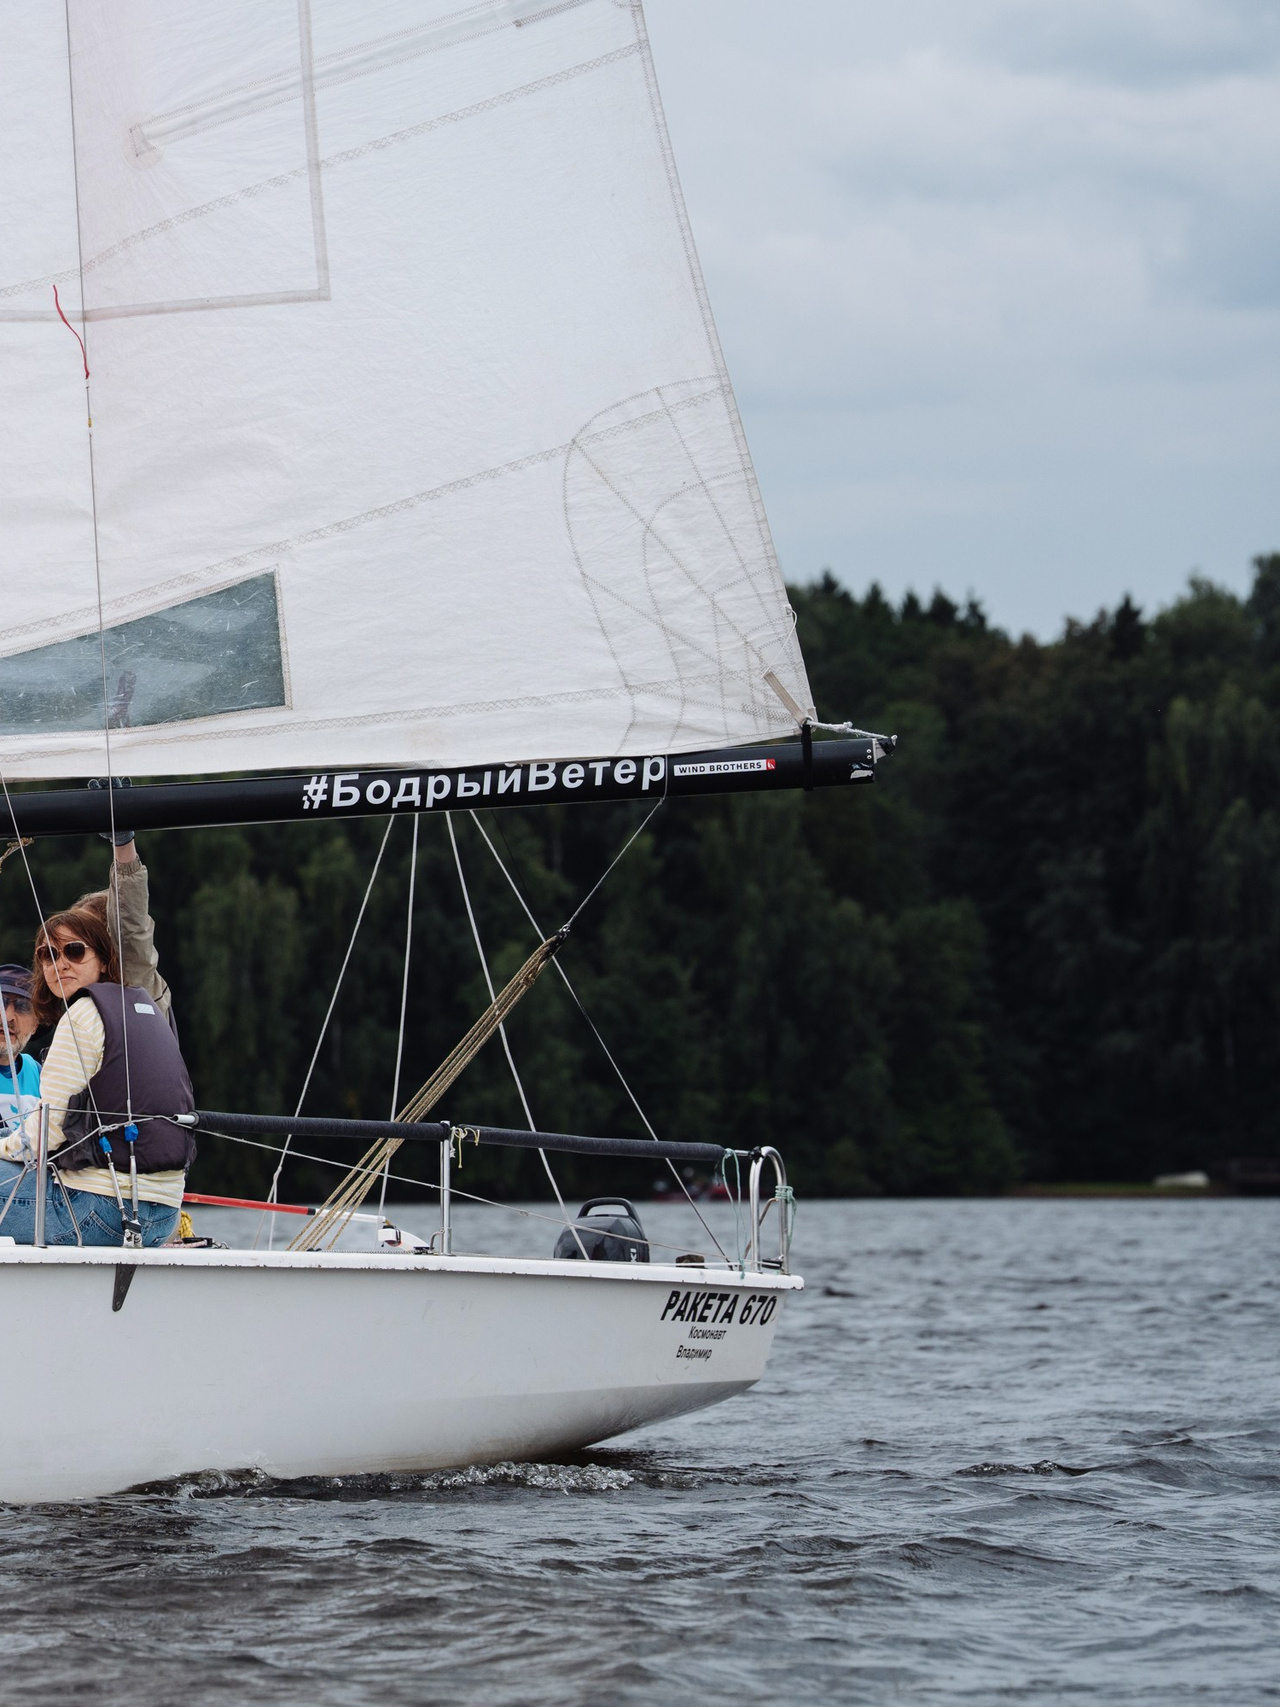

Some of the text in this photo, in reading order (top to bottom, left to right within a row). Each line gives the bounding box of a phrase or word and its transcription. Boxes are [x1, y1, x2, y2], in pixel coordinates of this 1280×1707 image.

[679, 762, 762, 774] WIND BROTHERS
[303, 756, 665, 809] #БодрыйВетер
[660, 1290, 777, 1326] РАКЕТА 670
[688, 1326, 727, 1340] Космонавт
[676, 1345, 712, 1362] Владимир
